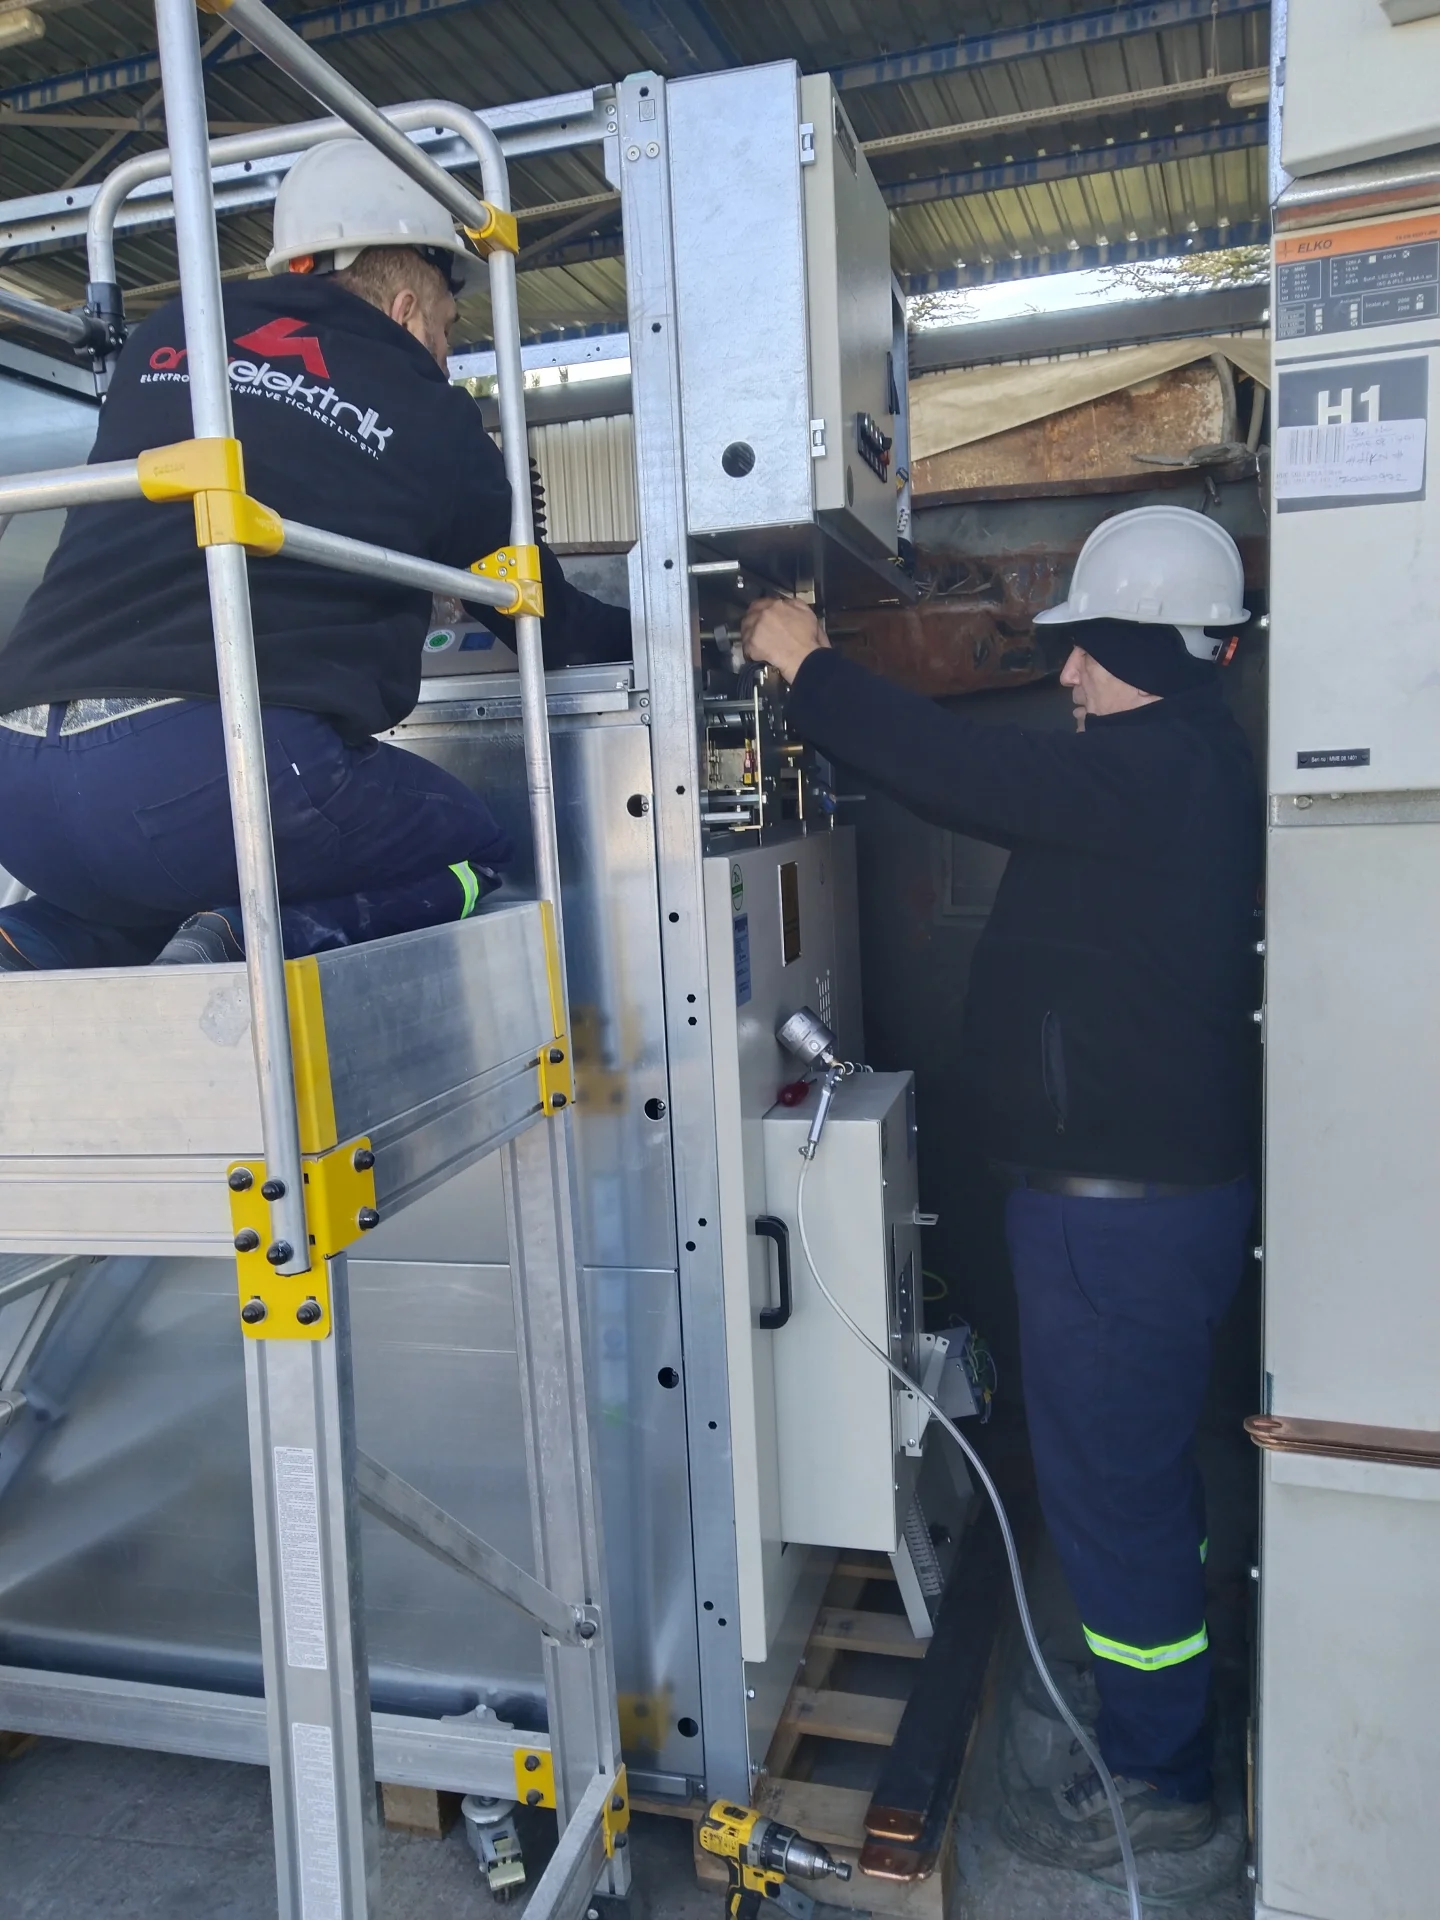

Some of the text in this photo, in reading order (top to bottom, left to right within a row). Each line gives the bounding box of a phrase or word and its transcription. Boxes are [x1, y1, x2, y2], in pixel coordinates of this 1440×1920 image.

[1298, 239, 1333, 254] ELKO
[140, 372, 190, 384] ELEKTRO
[265, 390, 281, 401] VE
[337, 425, 358, 443] LTD
[1317, 384, 1381, 426] H1
